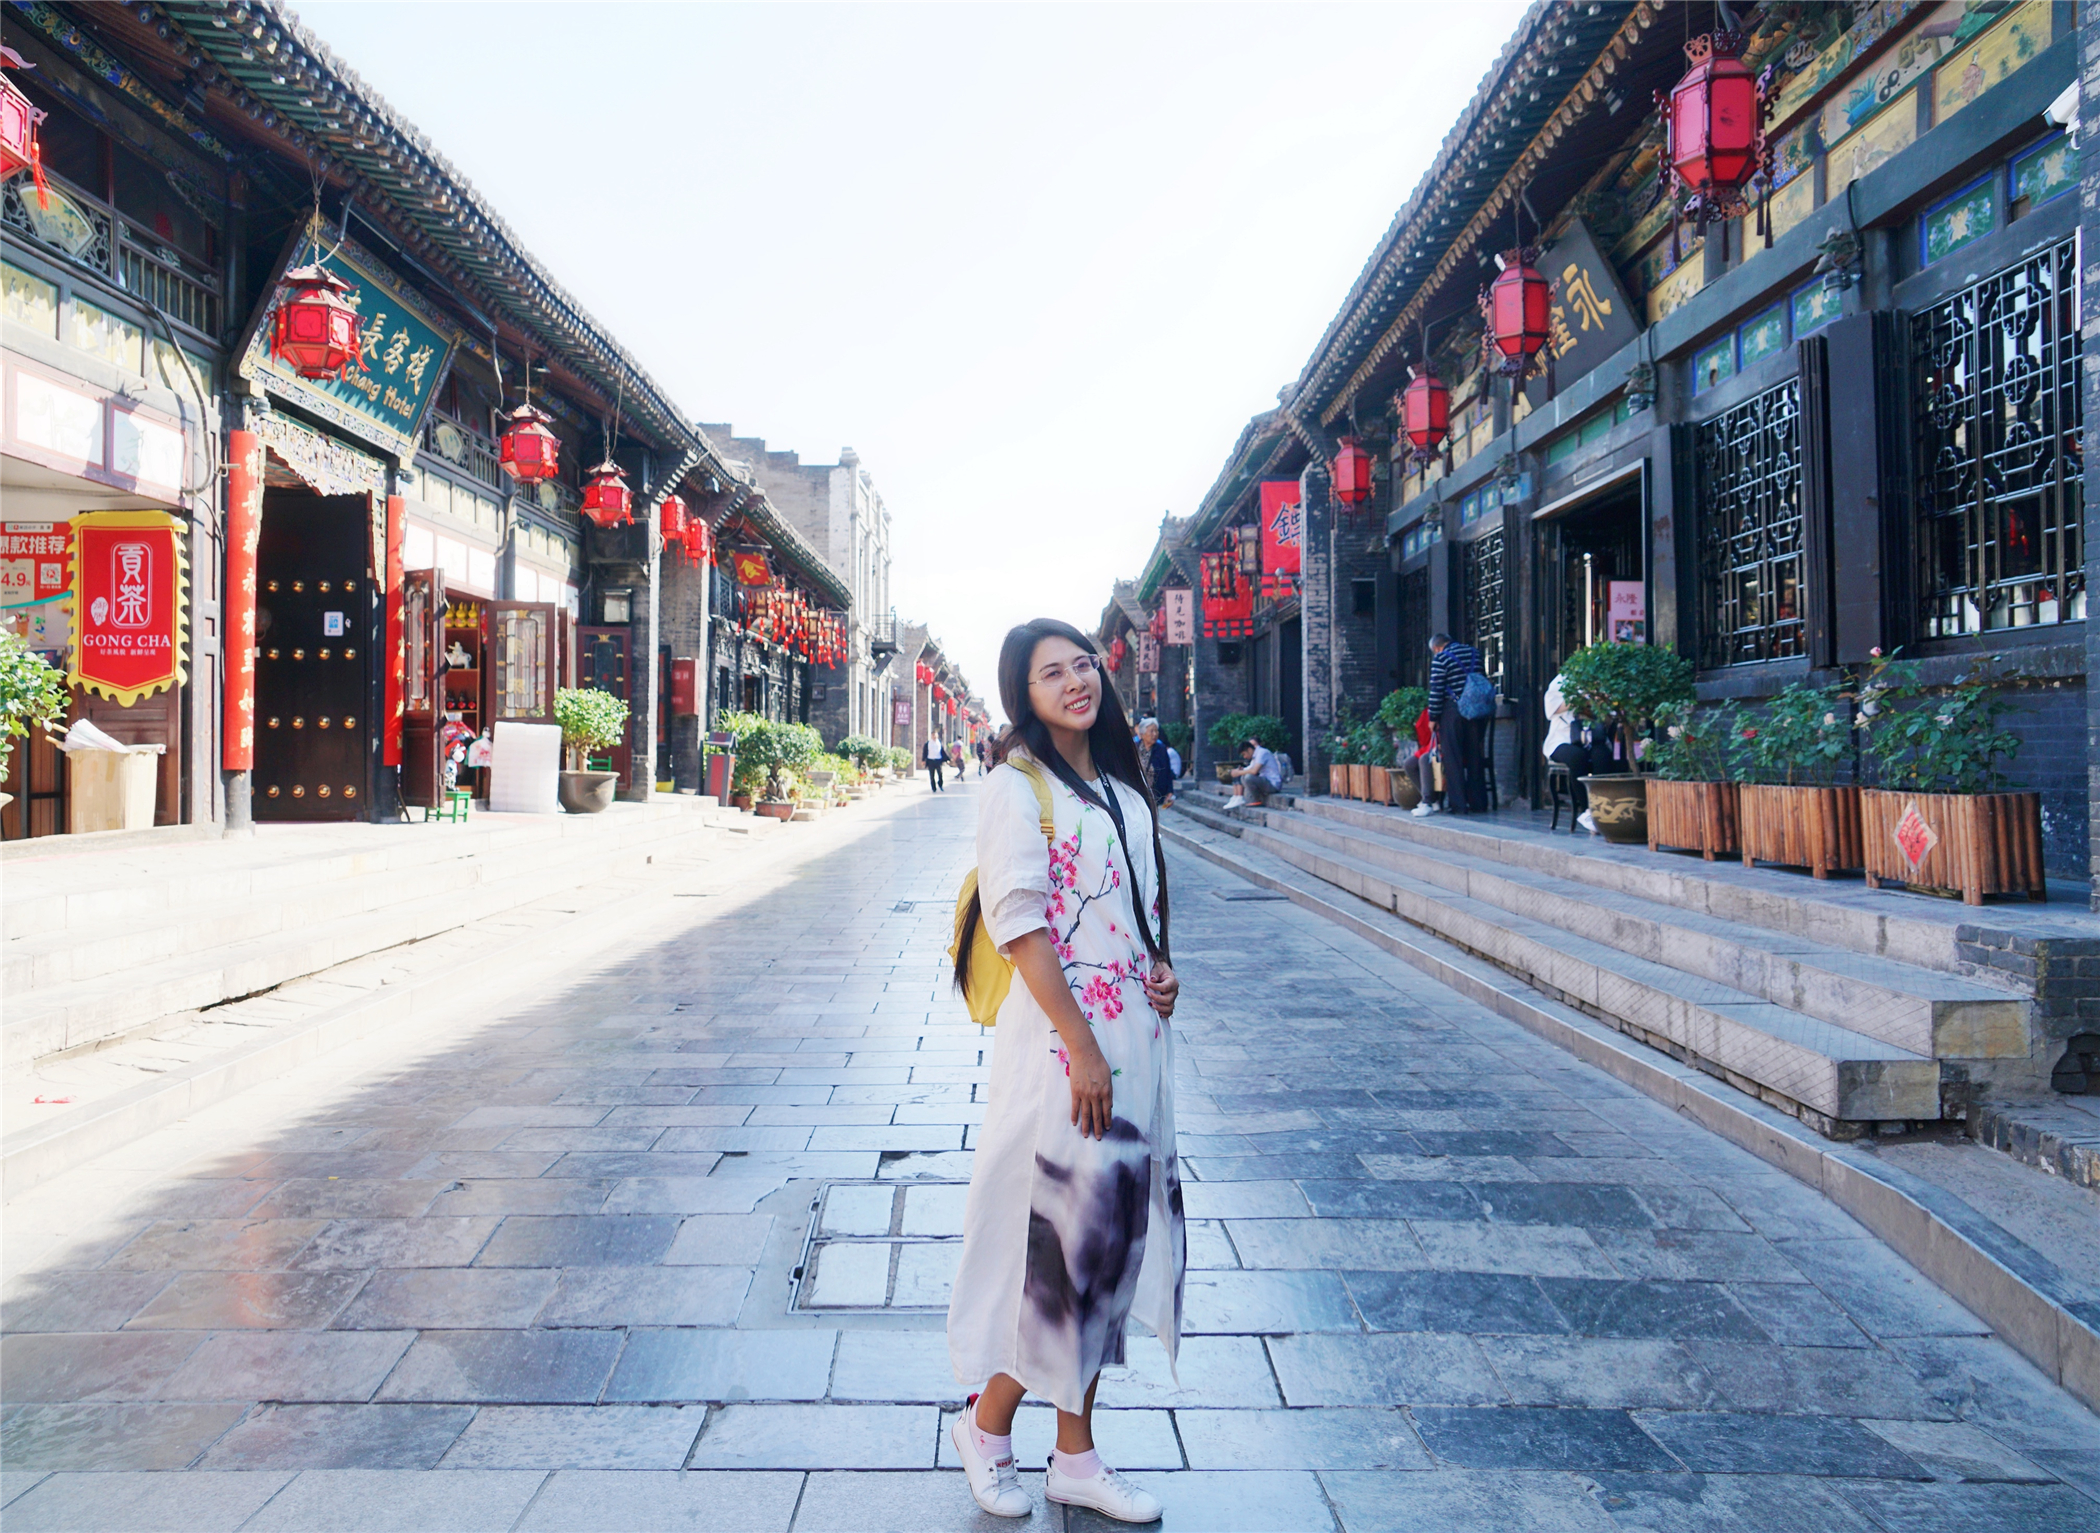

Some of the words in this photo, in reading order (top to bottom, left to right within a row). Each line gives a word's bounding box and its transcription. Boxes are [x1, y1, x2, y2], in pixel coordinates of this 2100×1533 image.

[345, 366, 382, 402] Chang
[383, 385, 416, 420] Hotel
[117, 546, 146, 624] 貢茶
[83, 634, 132, 647] GONG
[137, 634, 171, 648] CHA
